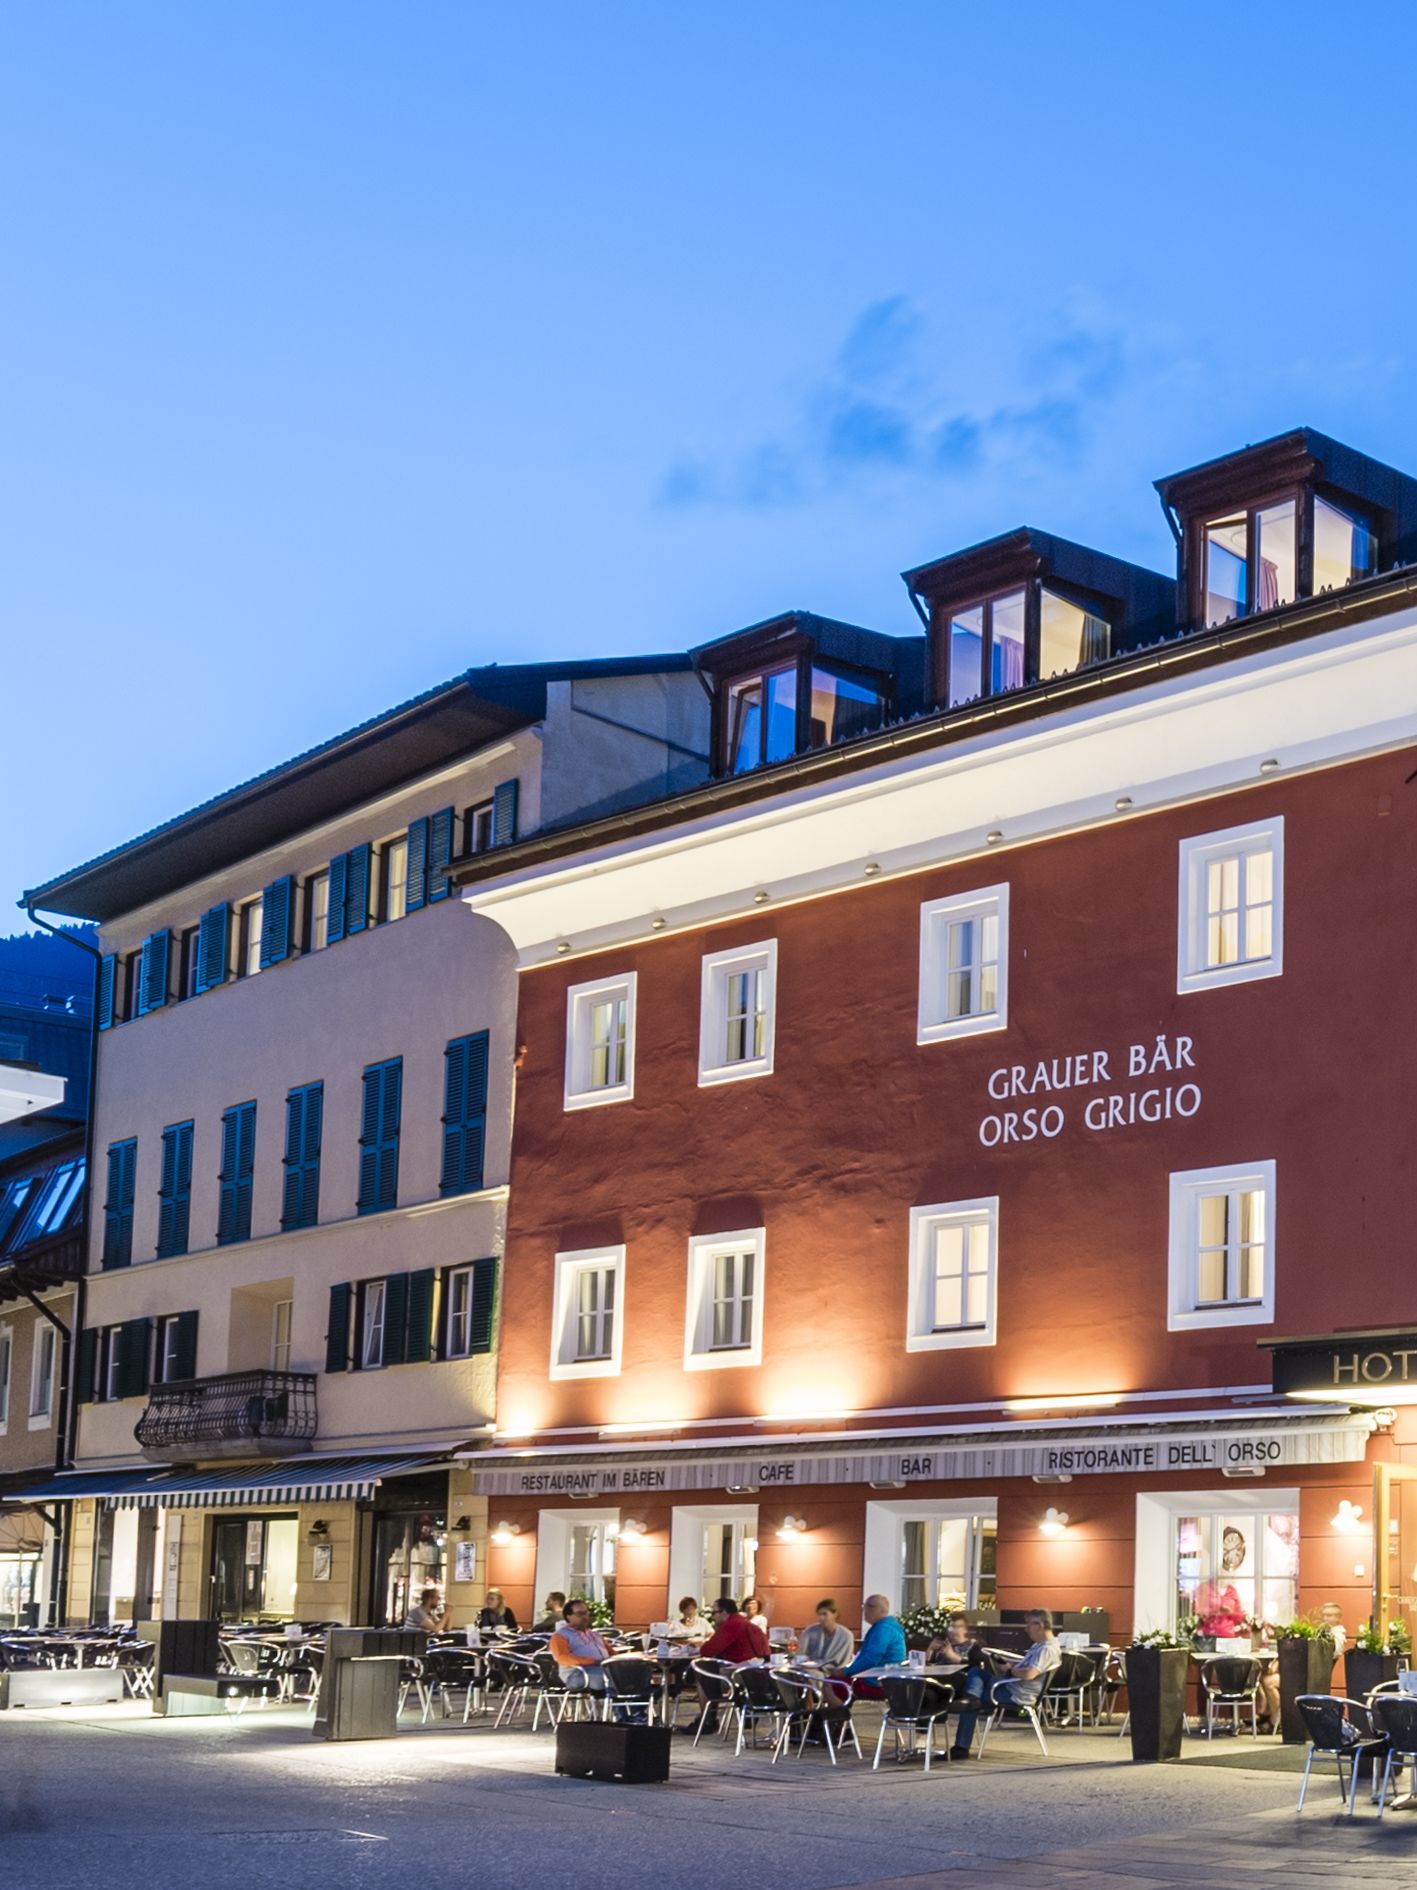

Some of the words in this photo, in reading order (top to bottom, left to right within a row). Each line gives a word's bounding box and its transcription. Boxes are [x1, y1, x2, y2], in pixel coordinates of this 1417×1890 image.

[988, 1050, 1111, 1100] GRAUER
[1128, 1034, 1196, 1077] BÄR
[979, 1105, 1065, 1147] ORSO
[1084, 1083, 1202, 1130] GRIGIO
[521, 1472, 597, 1490] RESTAURANT
[602, 1473, 616, 1488] IM
[623, 1470, 665, 1488] BÄREN
[759, 1464, 794, 1481] CAFE
[901, 1457, 932, 1475] BAR
[1049, 1447, 1154, 1469] RISTORANTE
[1228, 1441, 1281, 1461] ORSO
